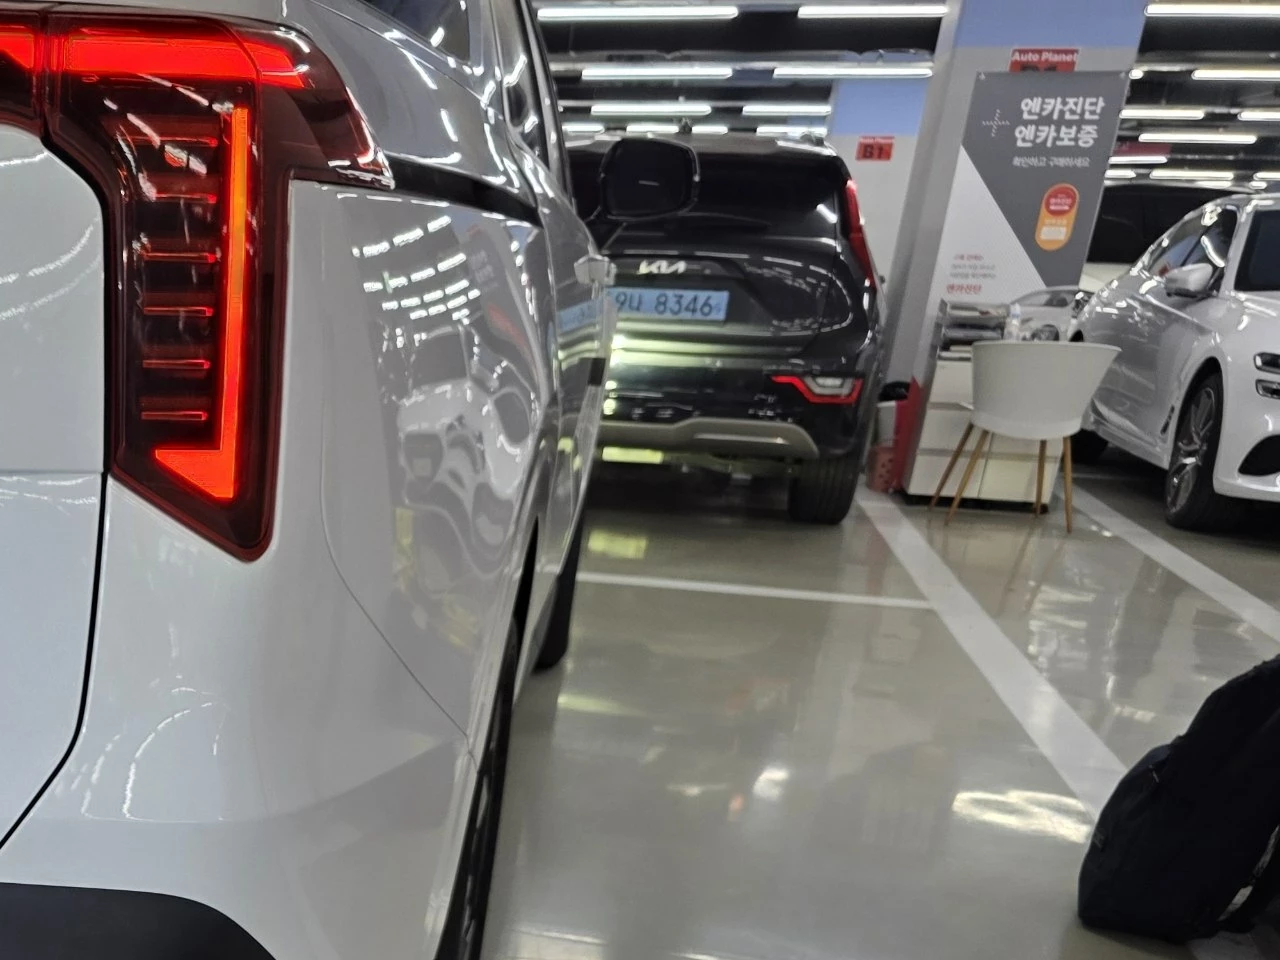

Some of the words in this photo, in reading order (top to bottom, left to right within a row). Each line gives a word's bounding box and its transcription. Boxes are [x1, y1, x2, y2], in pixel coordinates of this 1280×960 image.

[1012, 51, 1039, 62] Auto
[1041, 51, 1077, 62] Planet
[1021, 96, 1105, 120] 엔카진단
[1014, 124, 1098, 148] 엔카보증
[863, 144, 883, 159] B1
[655, 293, 713, 317] 8346
